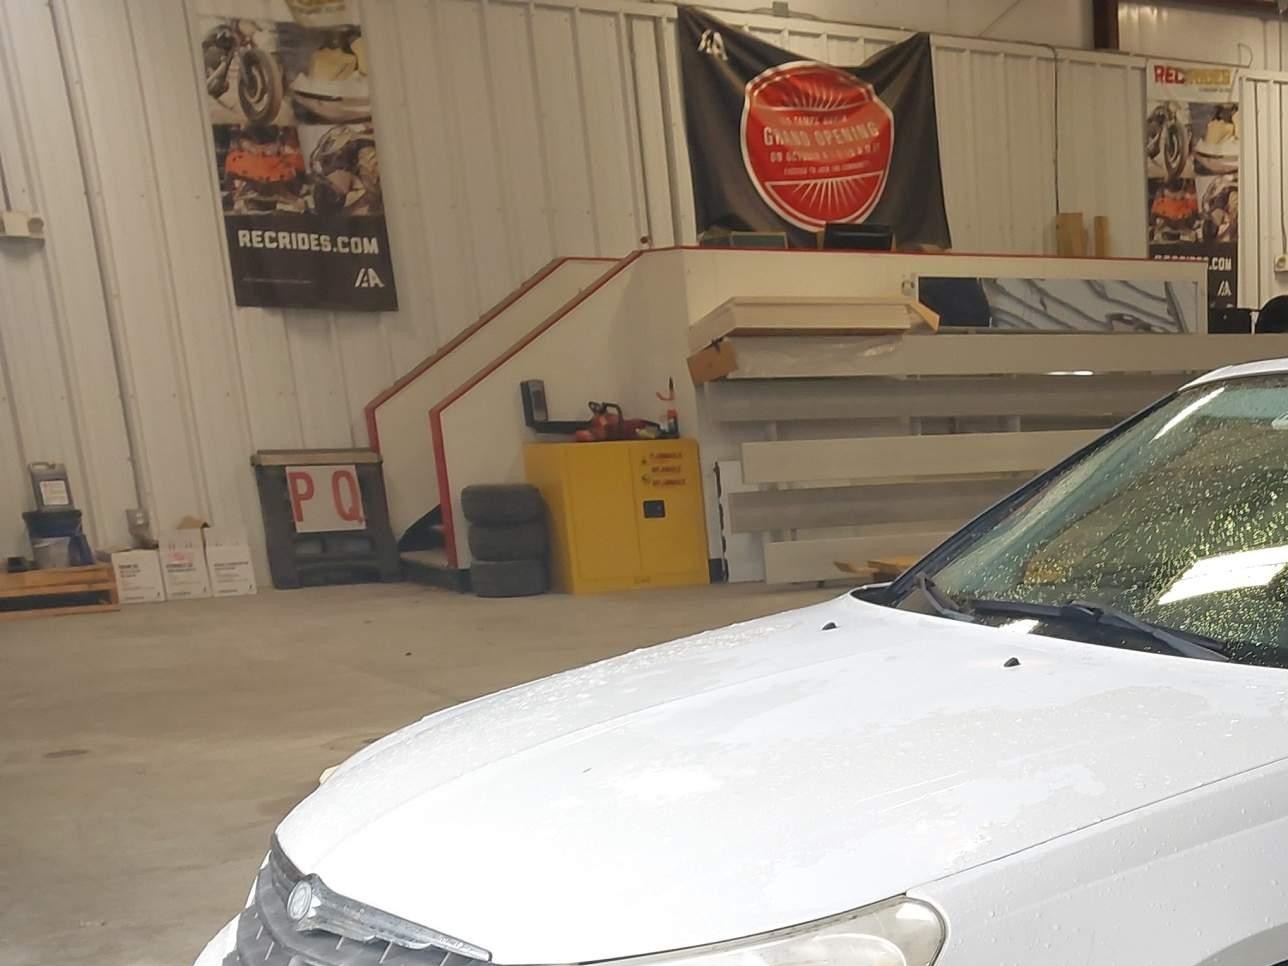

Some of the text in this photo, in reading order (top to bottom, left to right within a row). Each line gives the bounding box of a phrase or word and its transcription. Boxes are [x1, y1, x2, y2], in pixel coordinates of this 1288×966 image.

[814, 121, 880, 145] OPENING
[238, 230, 379, 254] RECRIDES.COM
[288, 470, 364, 524] P Q
